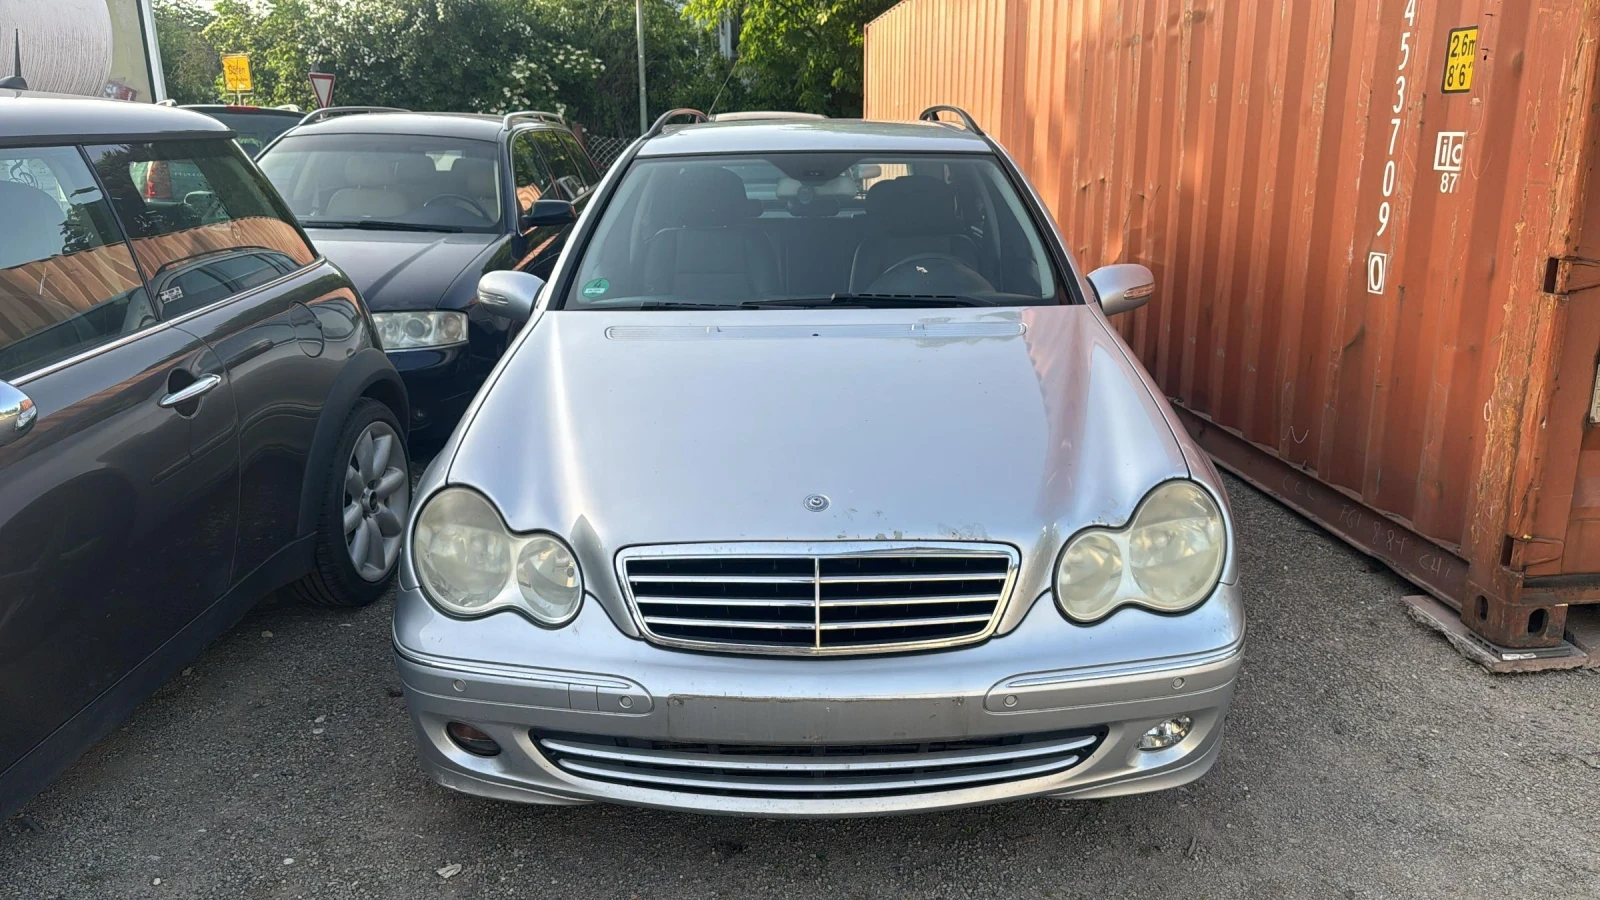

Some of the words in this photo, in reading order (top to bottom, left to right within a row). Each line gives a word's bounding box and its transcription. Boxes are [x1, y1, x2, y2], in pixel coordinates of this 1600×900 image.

[1440, 172, 1460, 194] 87
[593, 279, 602, 288] 4
[1369, 254, 1385, 292] 0
